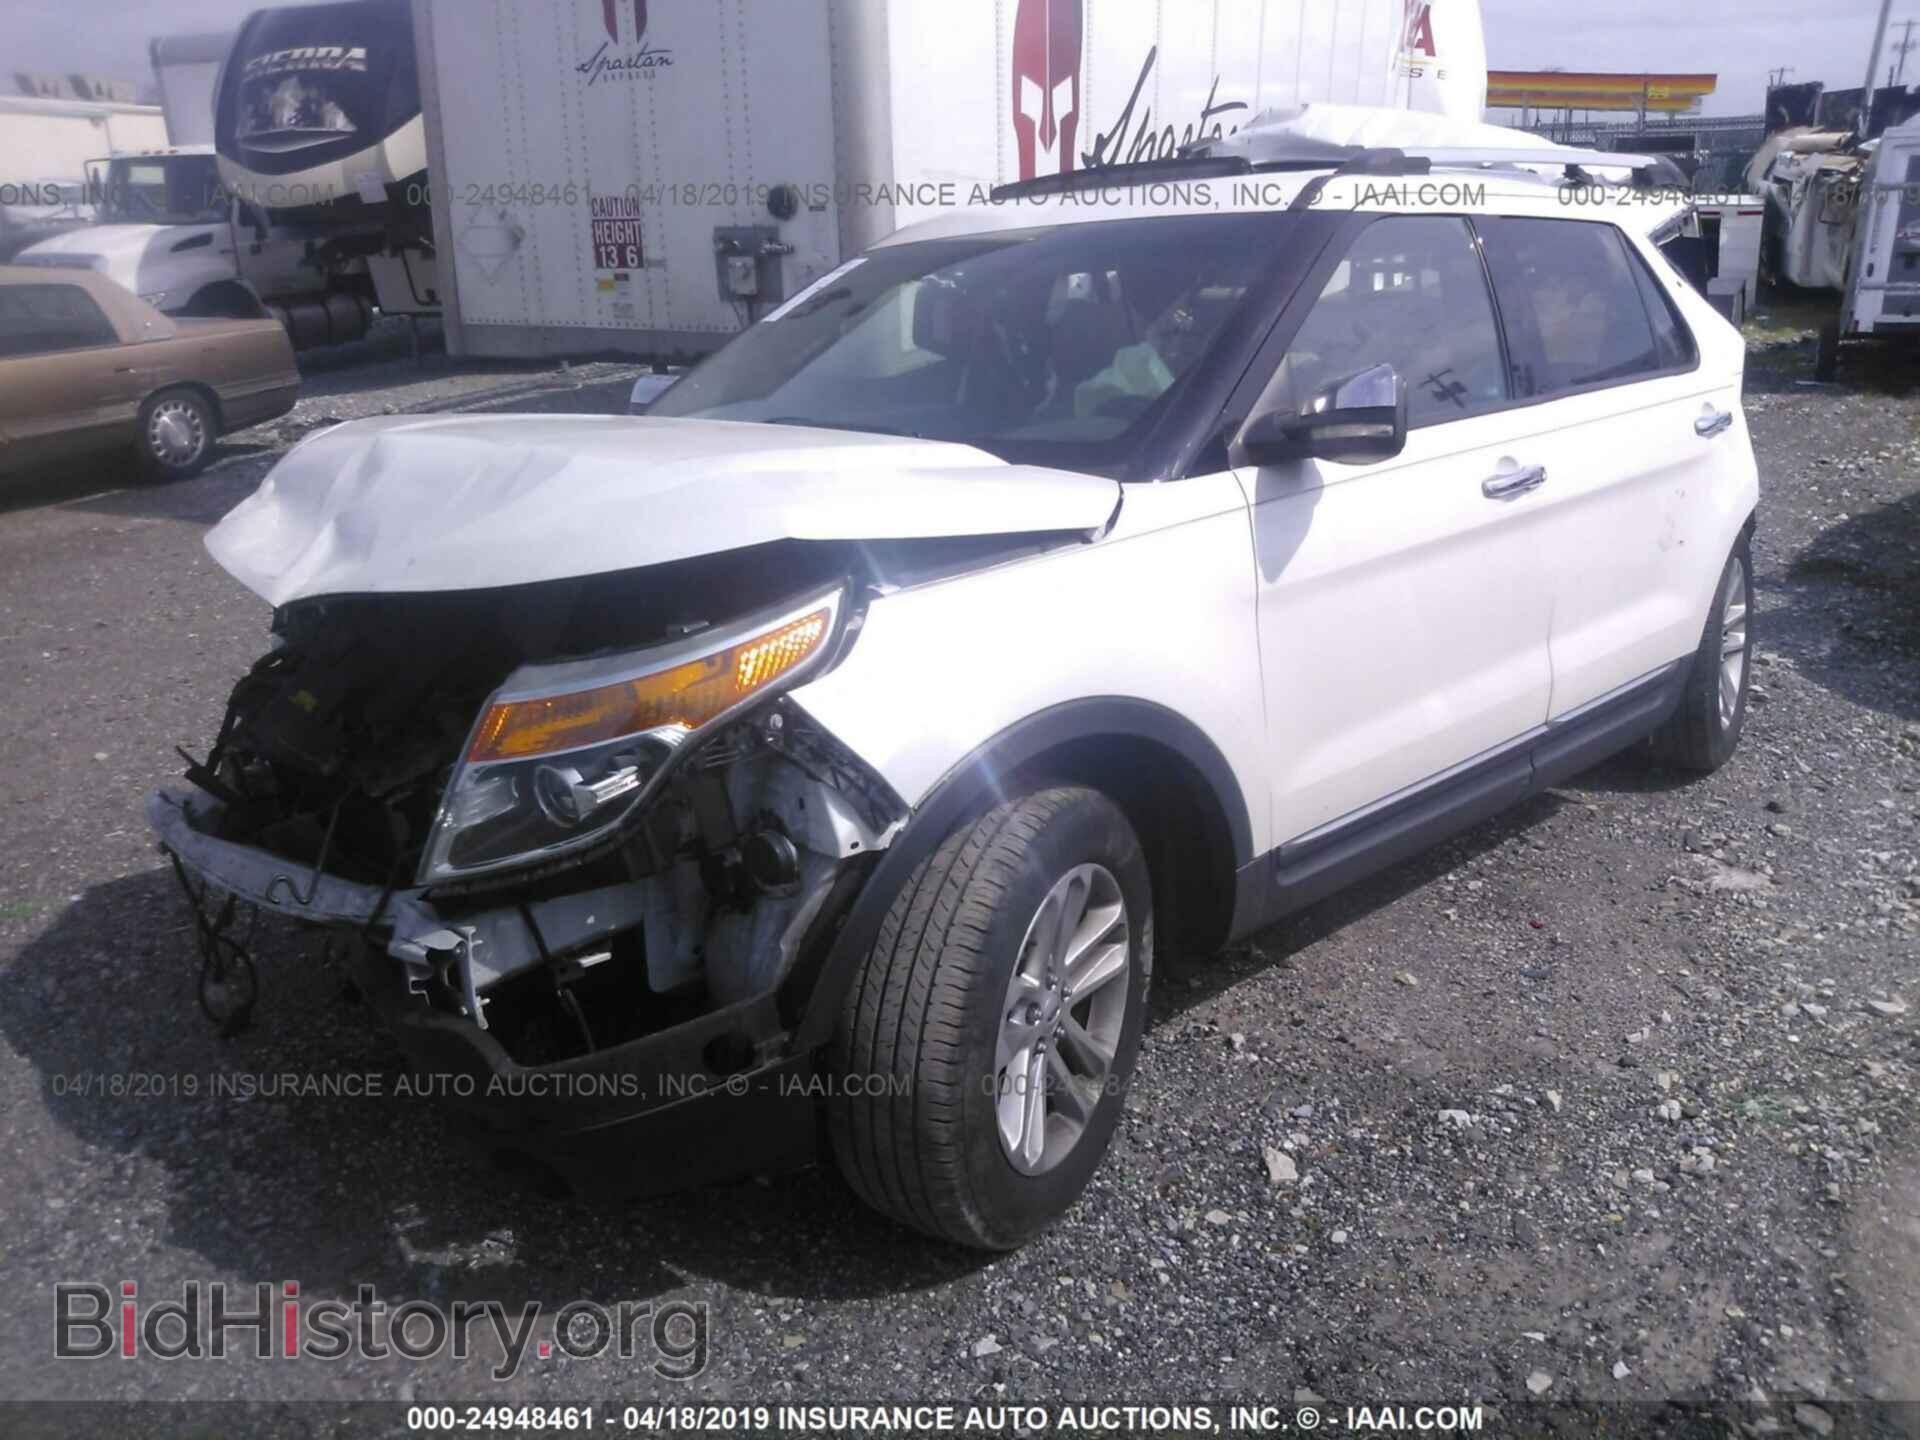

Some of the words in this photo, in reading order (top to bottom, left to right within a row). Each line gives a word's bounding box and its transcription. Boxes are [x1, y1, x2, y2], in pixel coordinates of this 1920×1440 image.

[574, 41, 674, 87] Spartan
[592, 196, 640, 217] CAUTION
[594, 221, 641, 246] HEIGHT
[600, 245, 618, 268] 13
[626, 245, 638, 268] 6
